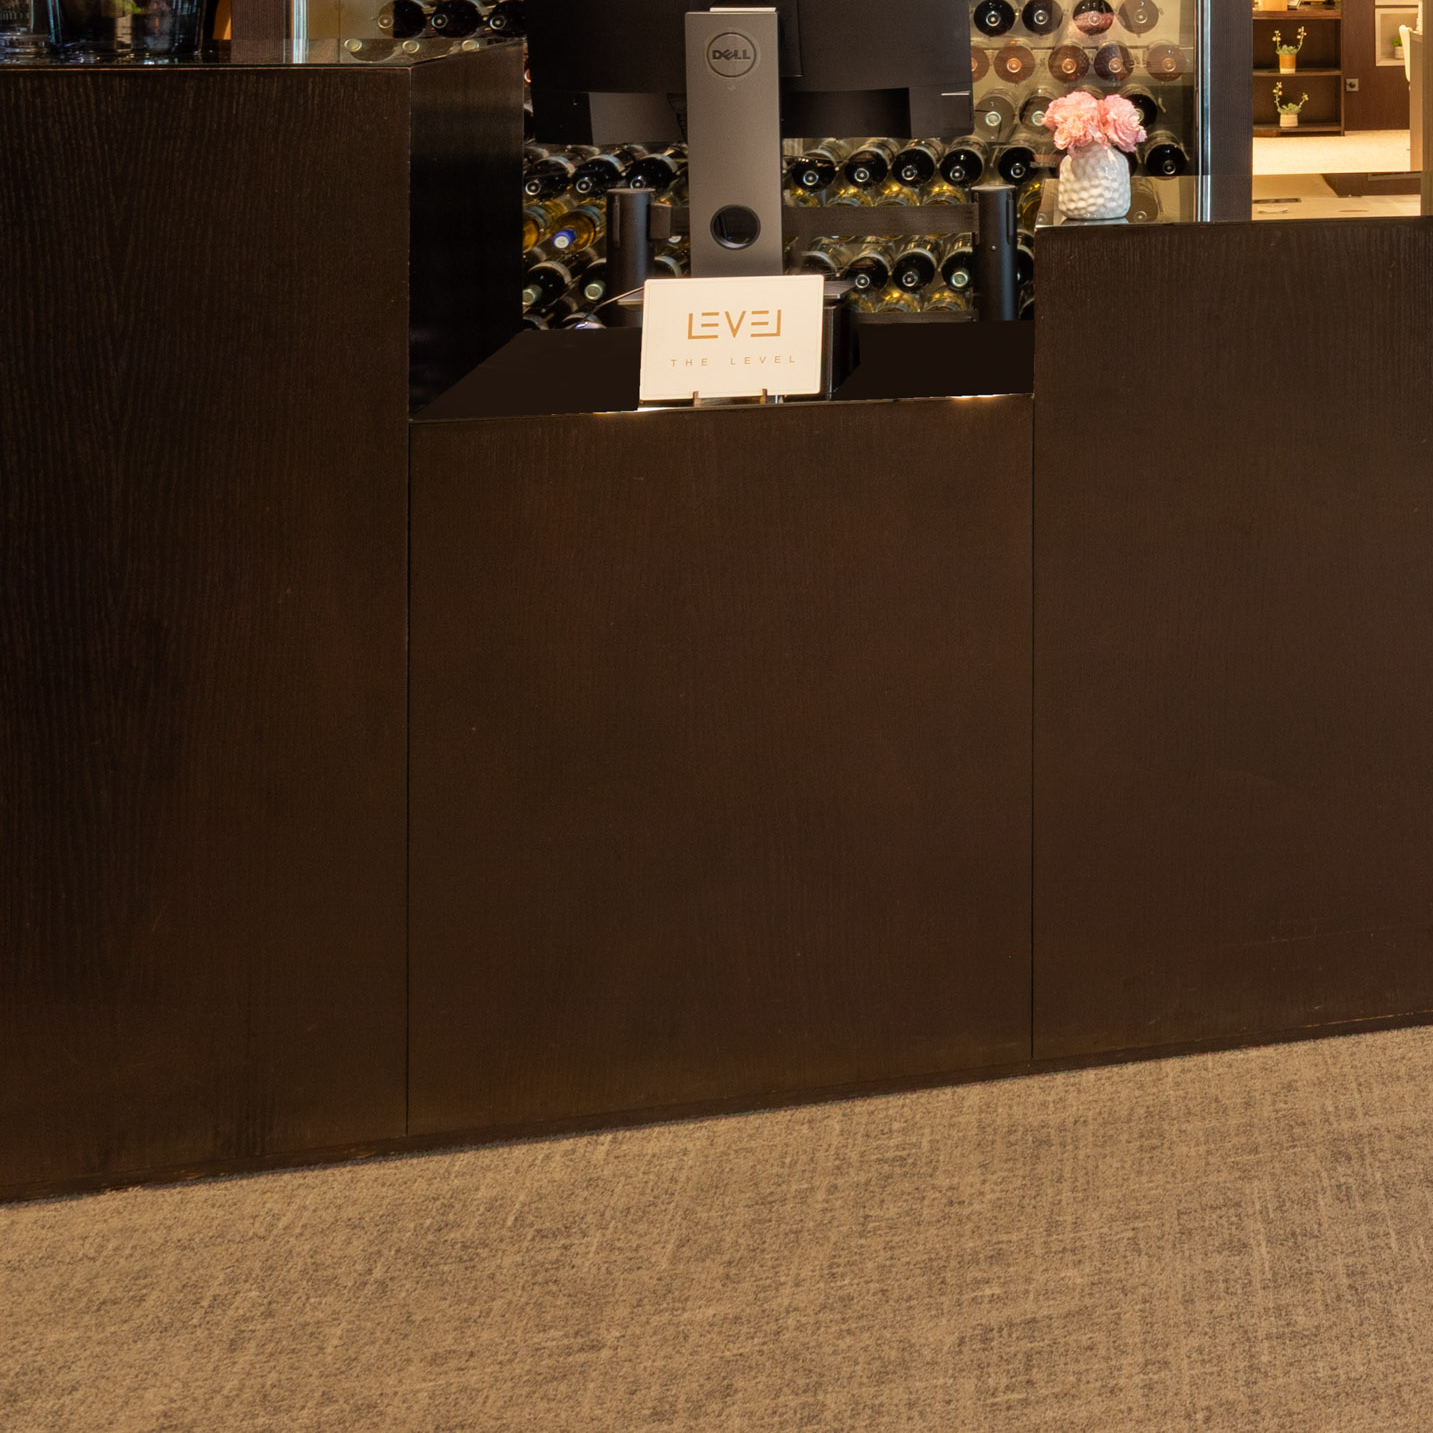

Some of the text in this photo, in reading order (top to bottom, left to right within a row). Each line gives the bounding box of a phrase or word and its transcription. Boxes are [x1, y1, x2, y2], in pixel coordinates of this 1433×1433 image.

[712, 49, 751, 60] DELL
[687, 309, 782, 340] LEVEL
[670, 354, 796, 367] THE LEVEL
